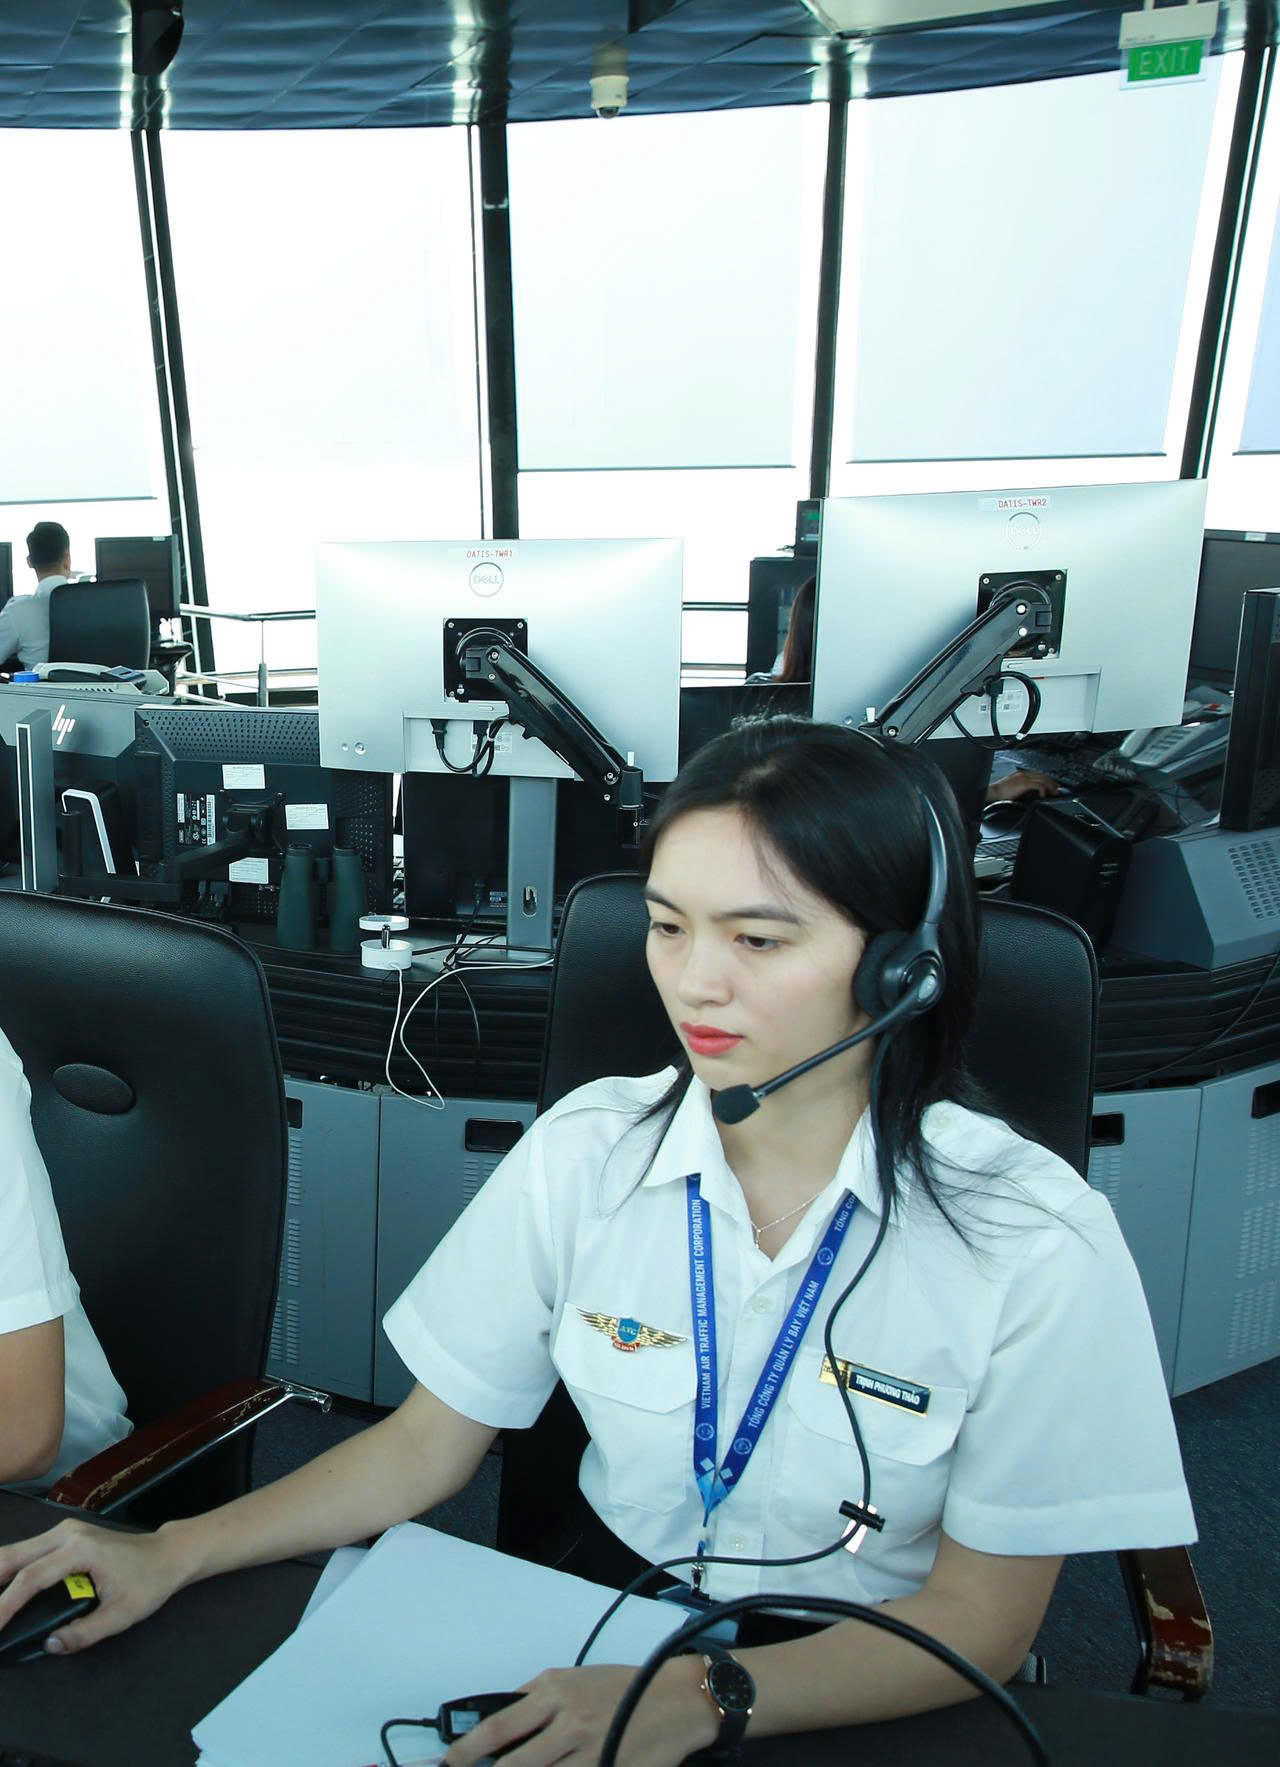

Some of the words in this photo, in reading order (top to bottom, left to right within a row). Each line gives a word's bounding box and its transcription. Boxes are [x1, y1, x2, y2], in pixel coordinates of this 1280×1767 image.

[1139, 46, 1191, 76] EXIT
[998, 498, 1047, 509] DATIS-TWR2
[466, 549, 513, 559] DATIS-TWR1
[472, 575, 500, 585] DELL
[52, 704, 76, 746] hp
[691, 1199, 705, 1257] CORPORATION
[694, 1259, 708, 1317] MANAGEMENT
[620, 1325, 637, 1336] ATC
[698, 1319, 710, 1353] TRAFFIC
[771, 1371, 780, 1383] TY
[788, 1318, 803, 1337] BAY
[805, 1280, 819, 1300] NAM
[701, 1354, 711, 1370] AIR
[701, 1372, 712, 1409] VIETNAM
